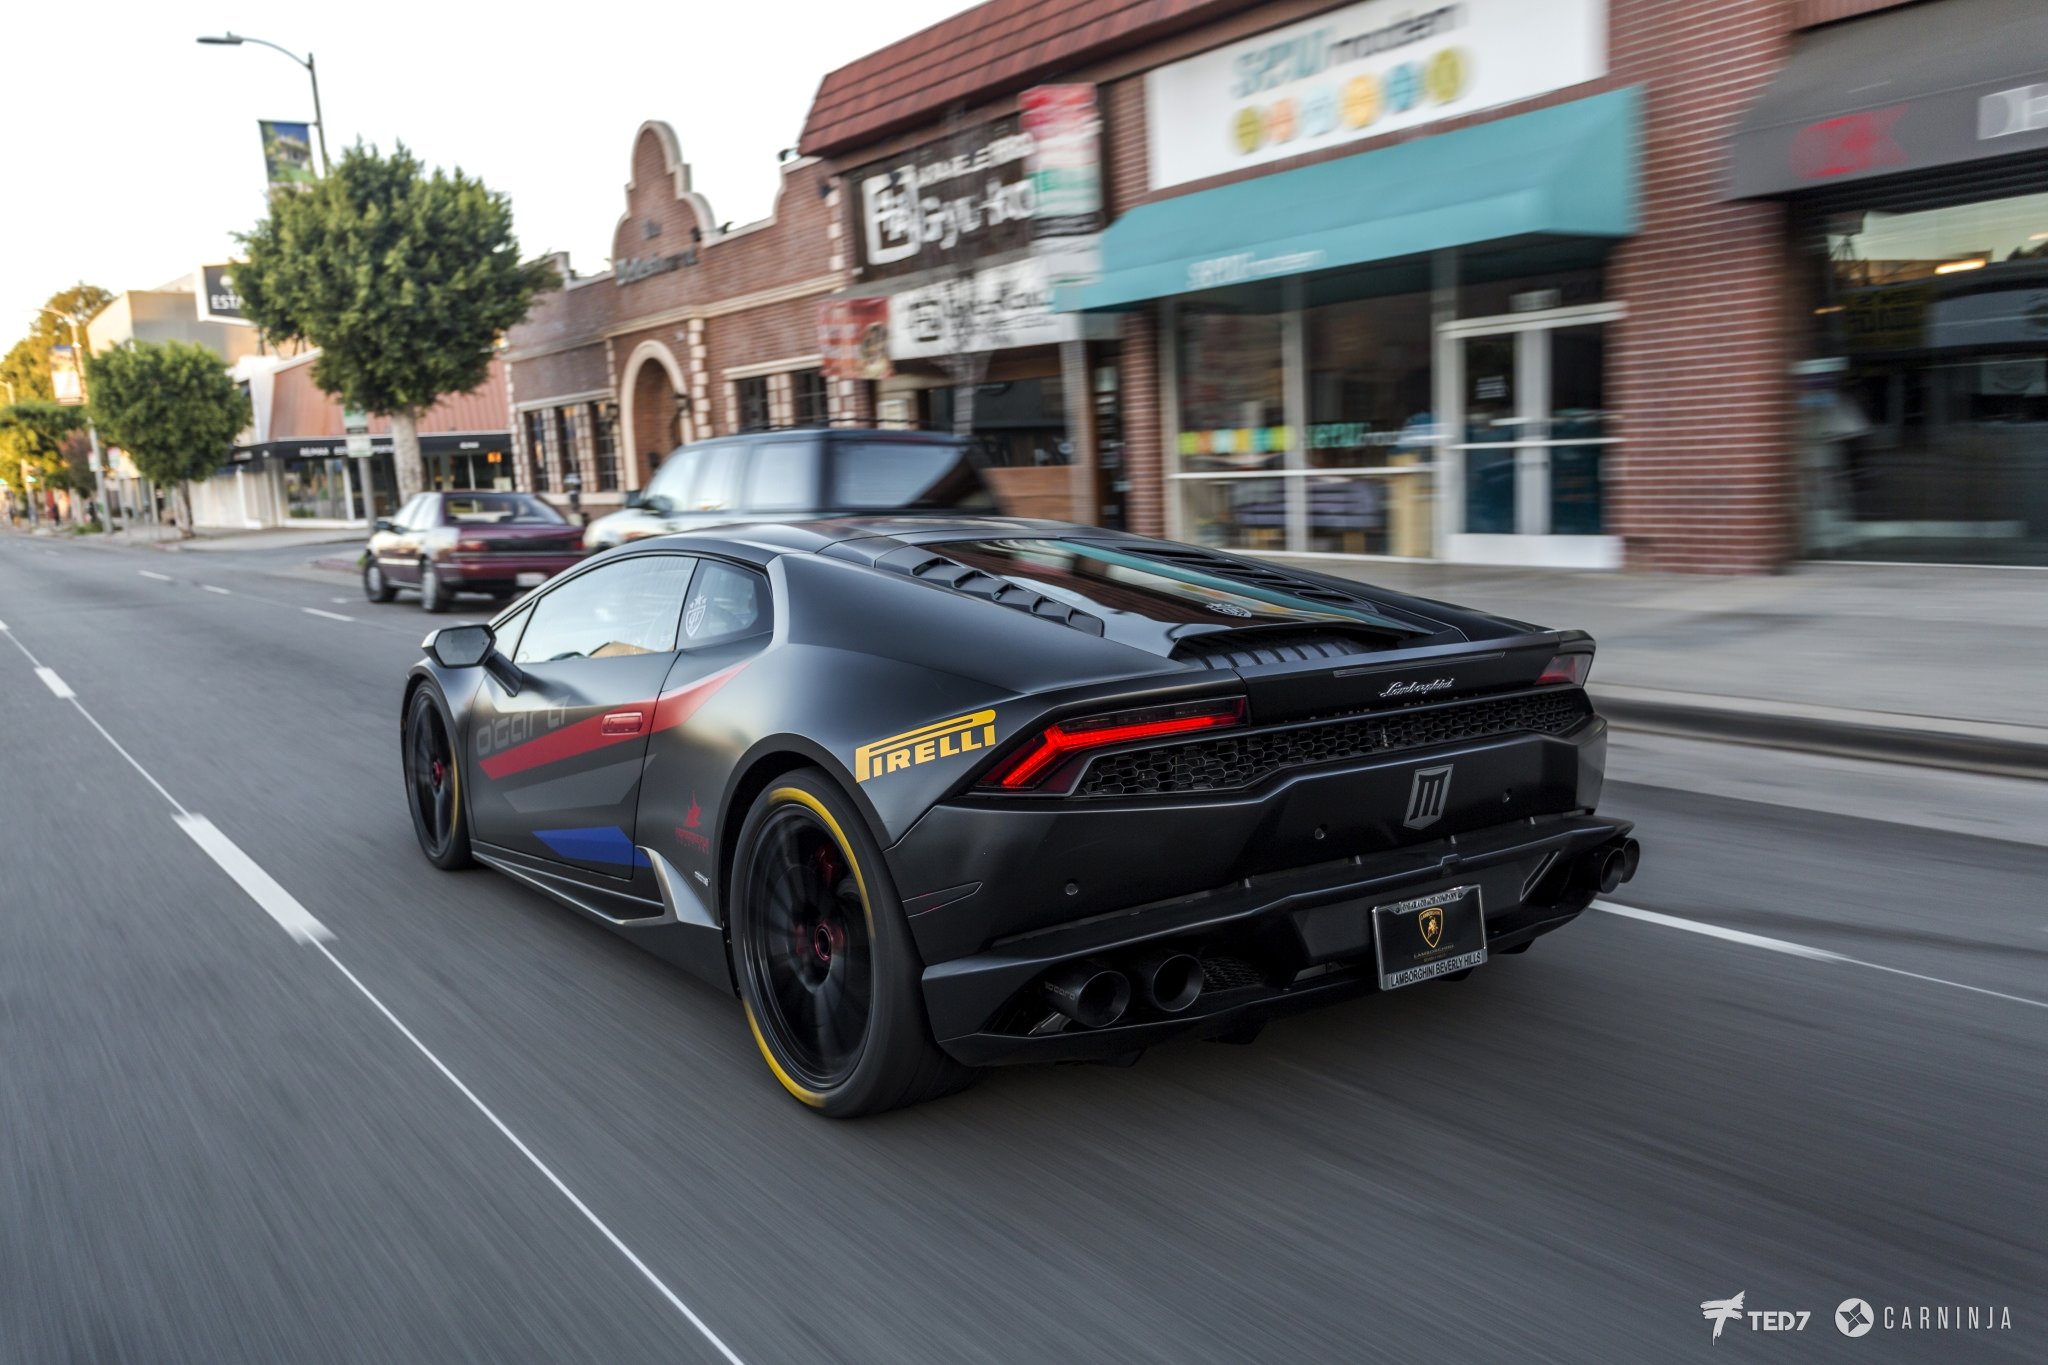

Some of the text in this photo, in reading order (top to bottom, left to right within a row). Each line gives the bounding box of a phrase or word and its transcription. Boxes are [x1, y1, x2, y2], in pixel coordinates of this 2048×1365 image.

[1380, 678, 1454, 697] Lamborghini
[856, 709, 996, 783] PIRELLI
[1390, 965, 1435, 987] LAMBORGHINI
[1435, 956, 1464, 975] BEVERLY
[1464, 951, 1481, 967] HILLS
